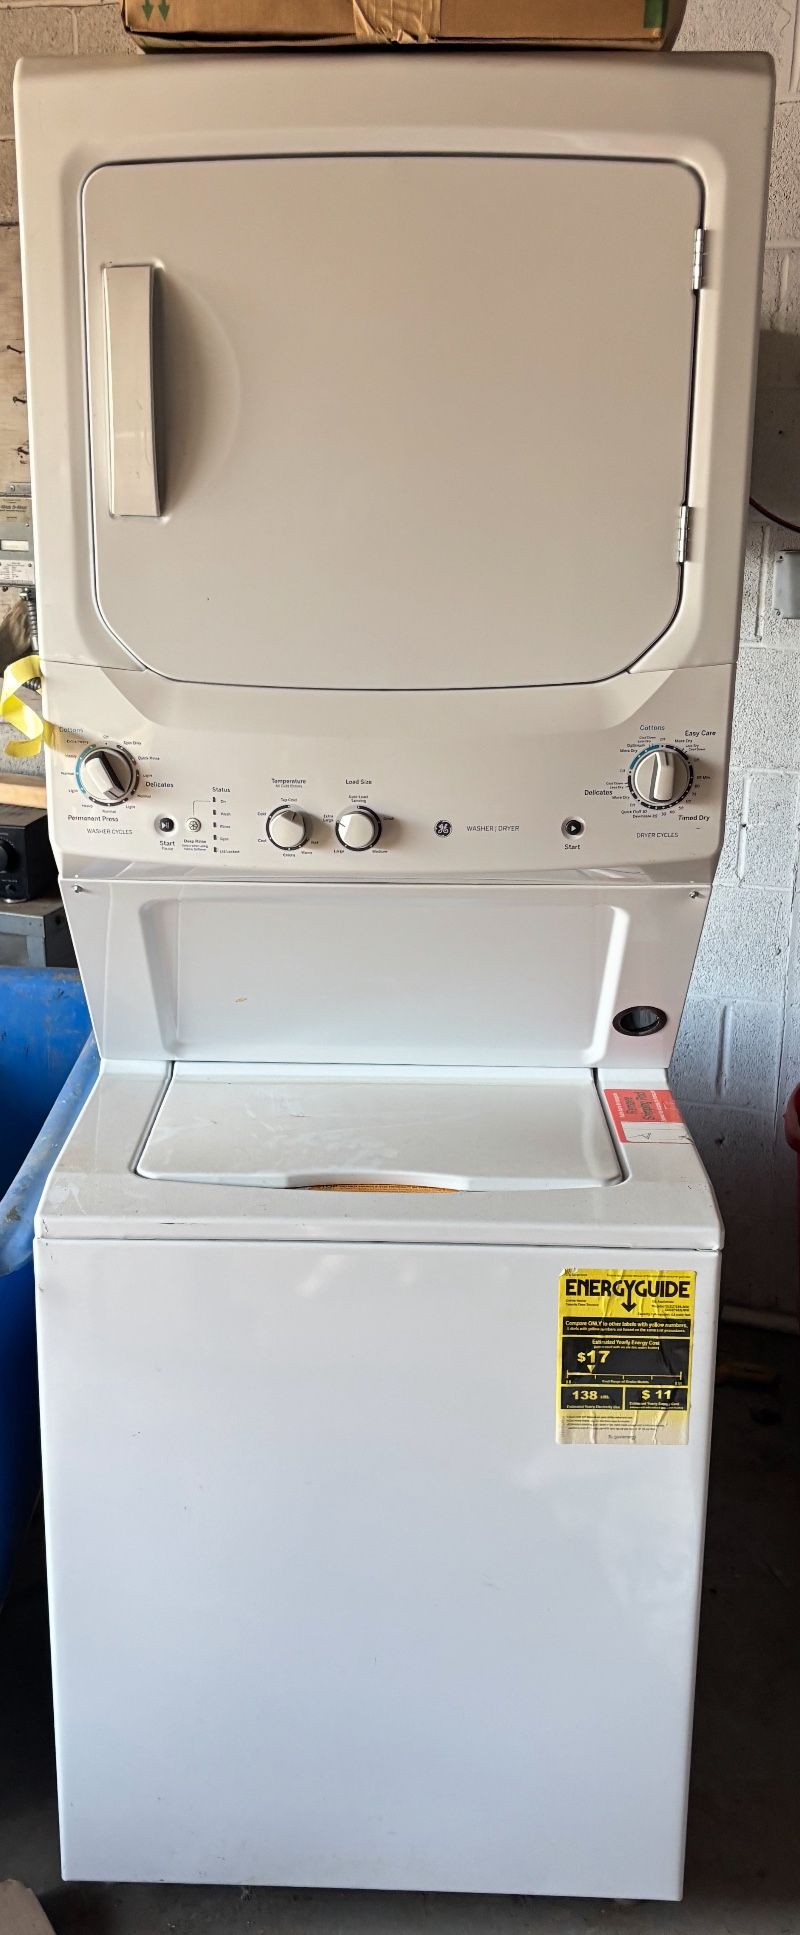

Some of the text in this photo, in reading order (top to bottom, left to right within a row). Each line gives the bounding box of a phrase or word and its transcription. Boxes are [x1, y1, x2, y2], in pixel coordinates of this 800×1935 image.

[566, 1279, 690, 1298] ENERGYGUIDE
[578, 1350, 610, 1363] $17
[572, 1390, 597, 1400] 138
[642, 1390, 671, 1400] $ 11
